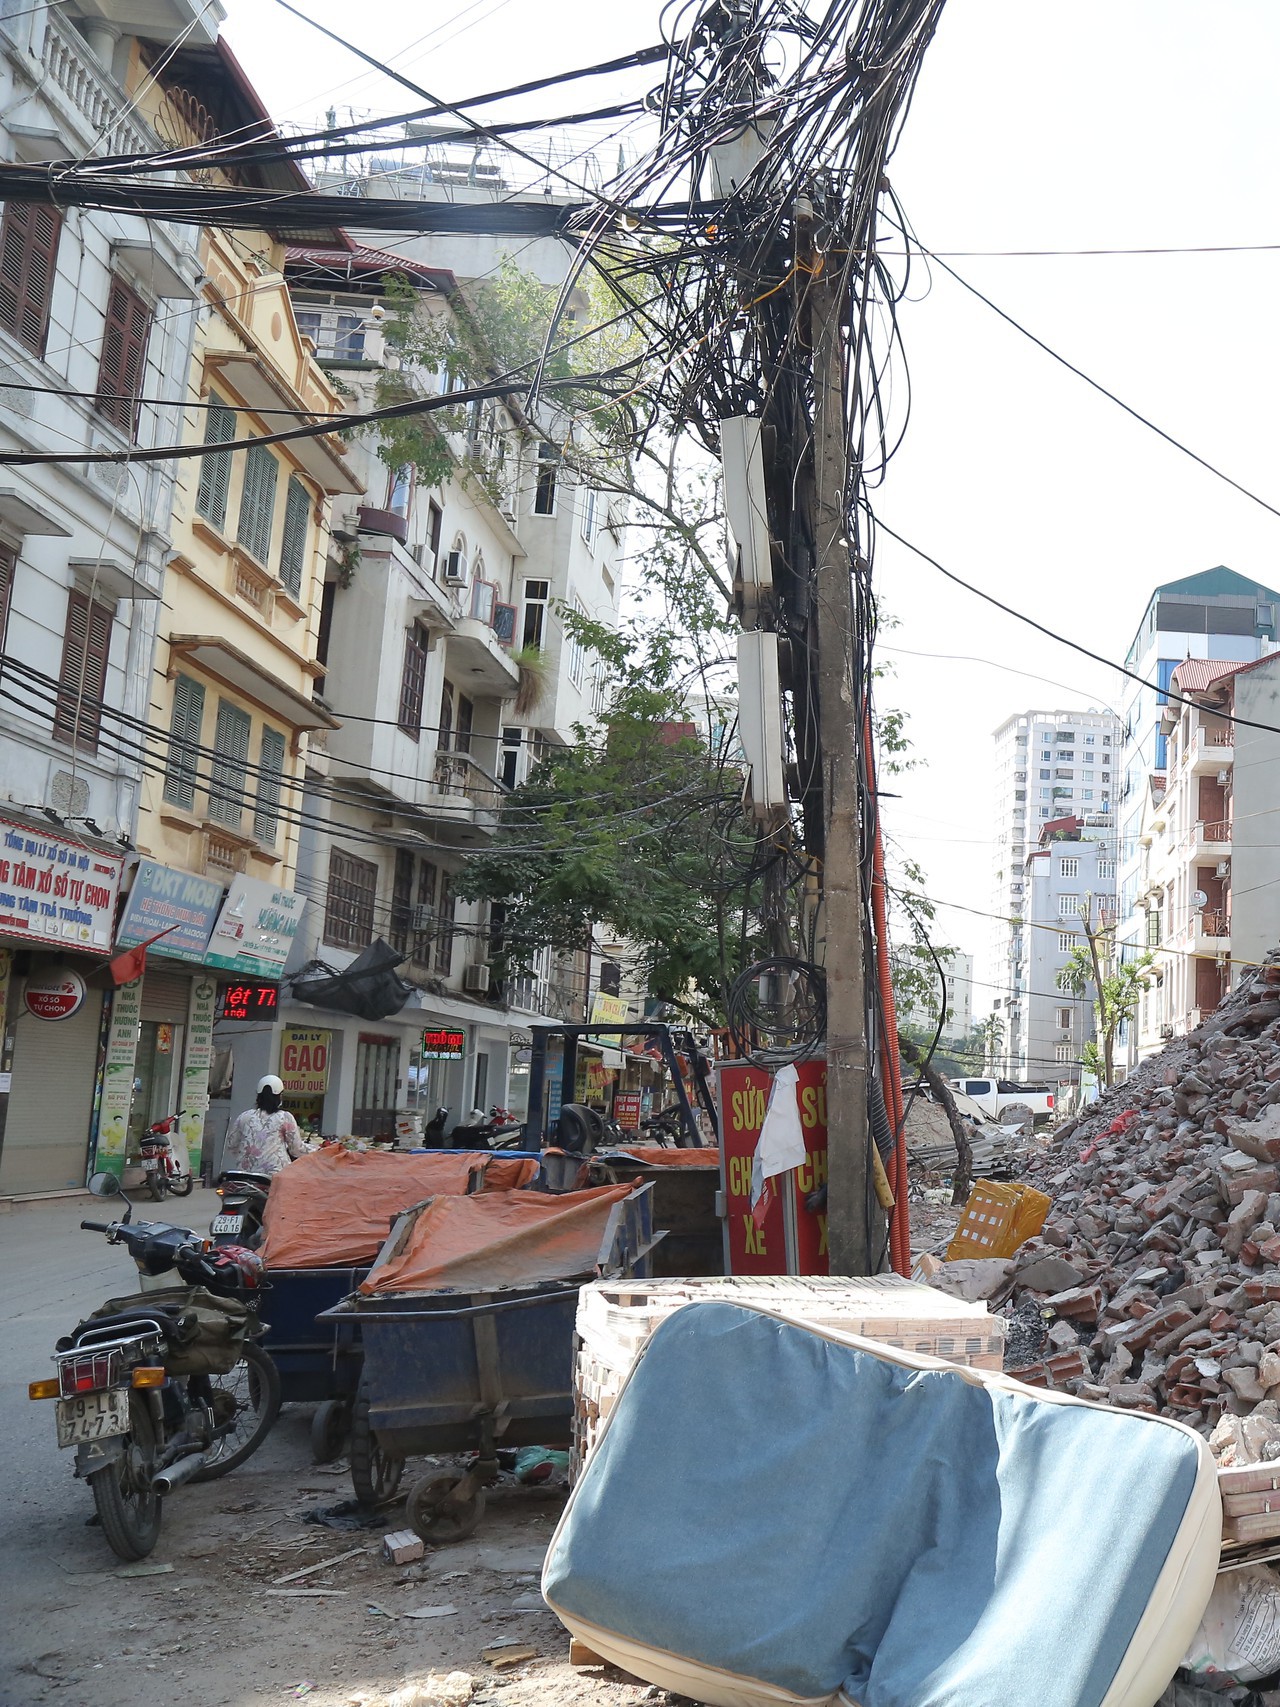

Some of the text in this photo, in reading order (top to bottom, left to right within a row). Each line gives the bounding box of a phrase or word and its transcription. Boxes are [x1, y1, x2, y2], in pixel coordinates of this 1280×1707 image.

[84, 883, 110, 911] CHỌN
[151, 869, 219, 909] DKT MOBI
[117, 1029, 132, 1038] ANH
[194, 1036, 206, 1044] ANH
